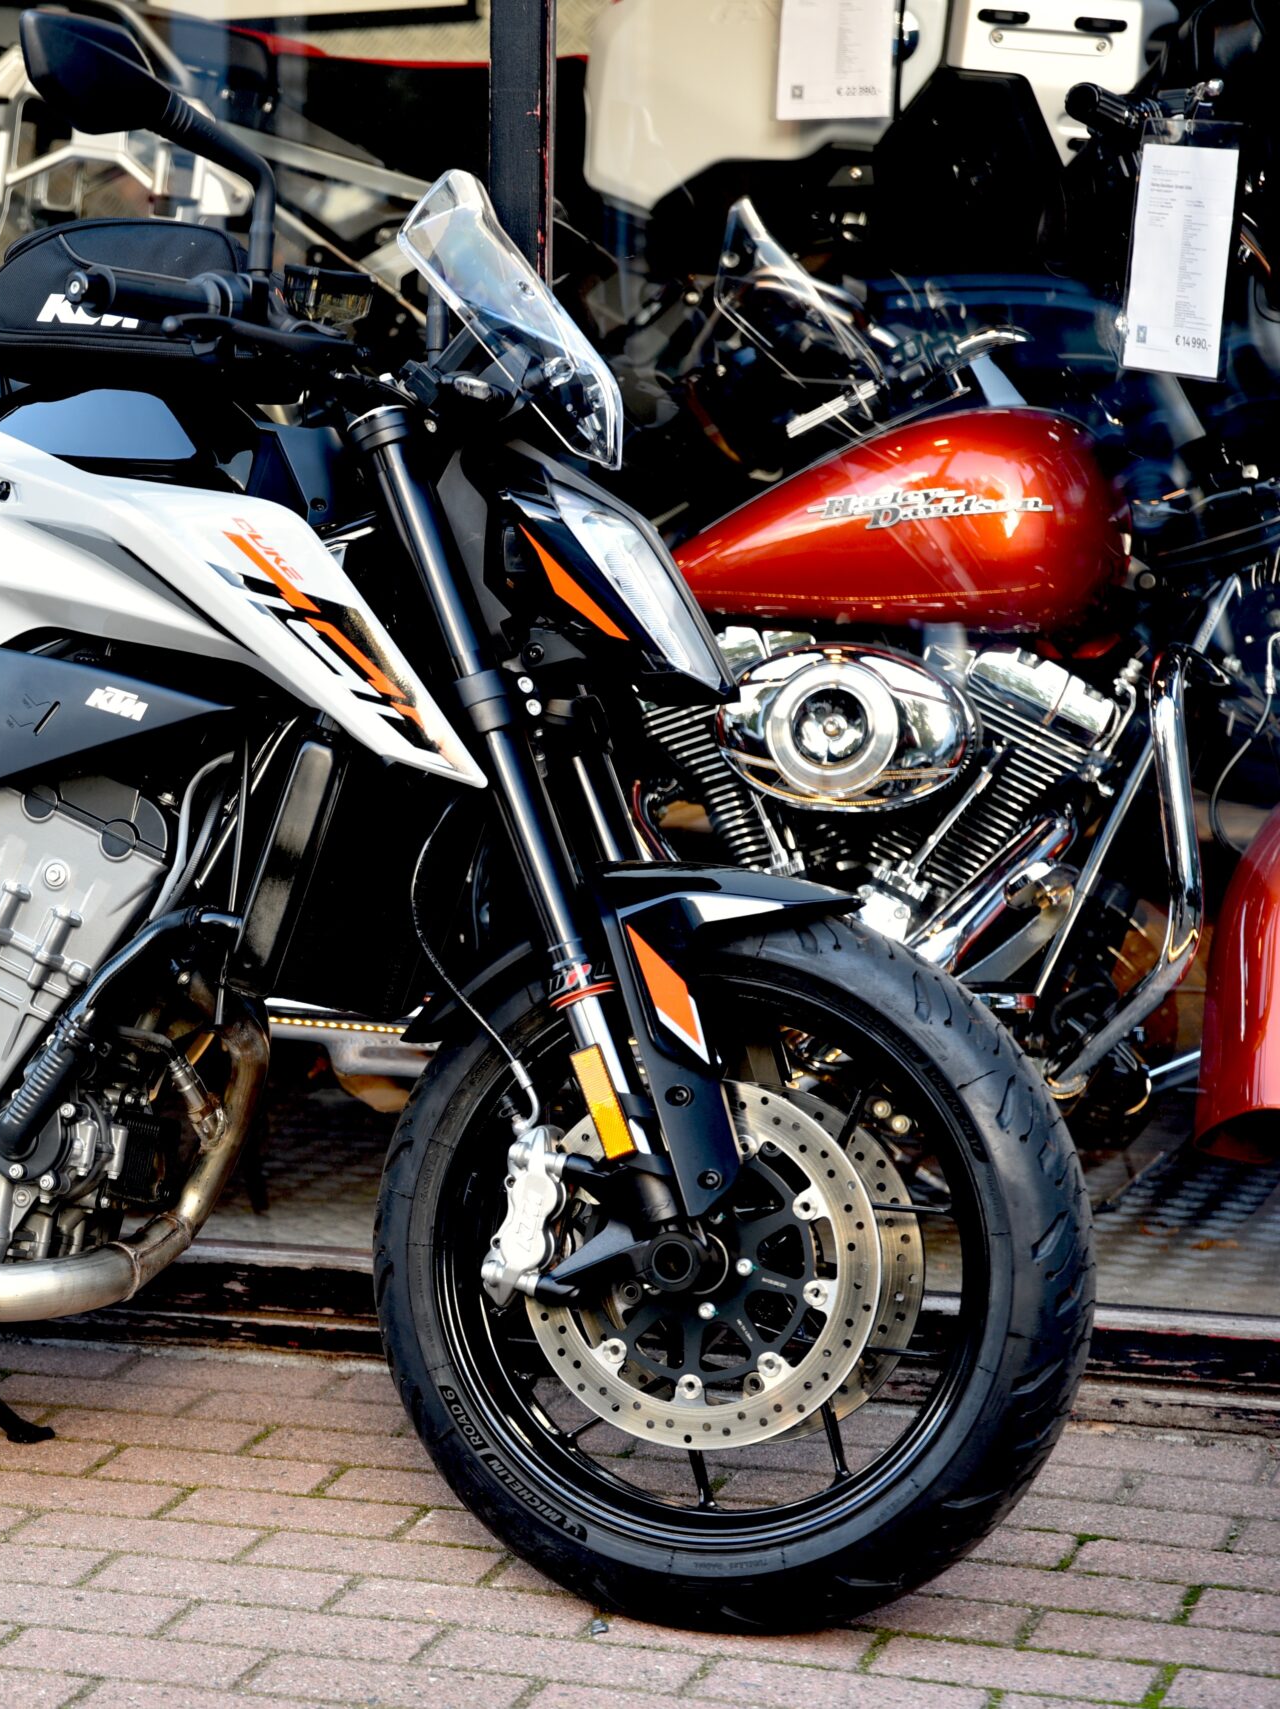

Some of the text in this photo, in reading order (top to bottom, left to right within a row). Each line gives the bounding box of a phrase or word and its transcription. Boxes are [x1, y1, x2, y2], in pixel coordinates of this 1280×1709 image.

[818, 488, 958, 519] Harley
[231, 517, 304, 581] DUKE
[84, 686, 149, 722] KTM
[443, 1389, 563, 1523] MICHELIN ROAD 6
